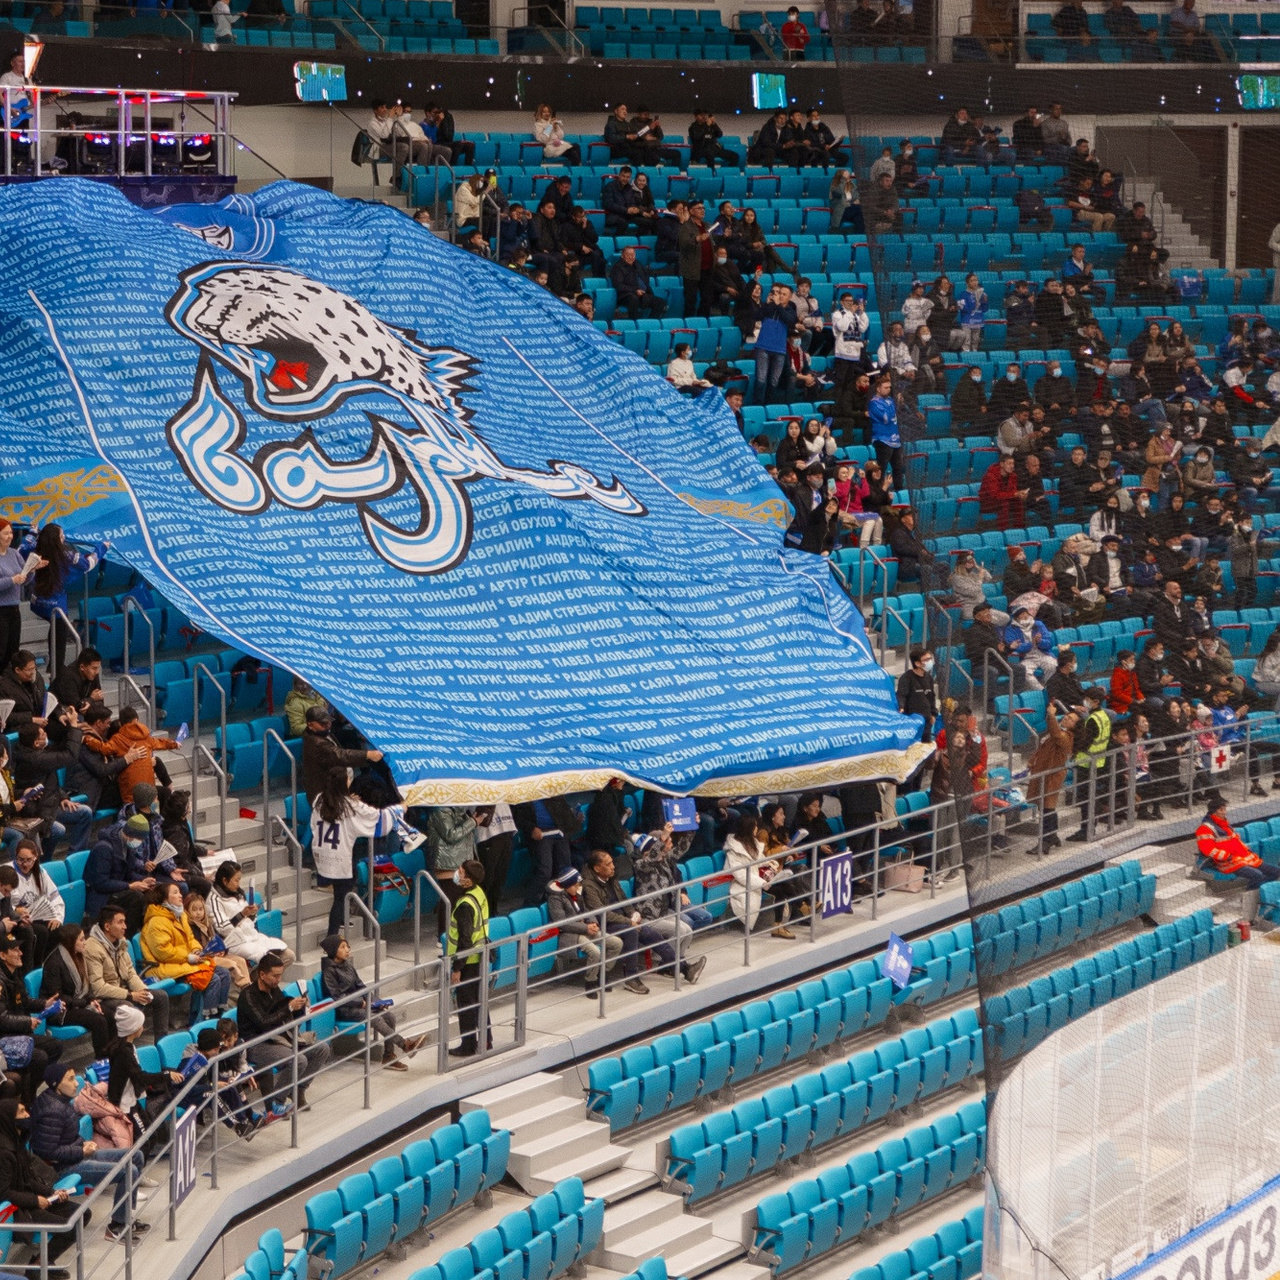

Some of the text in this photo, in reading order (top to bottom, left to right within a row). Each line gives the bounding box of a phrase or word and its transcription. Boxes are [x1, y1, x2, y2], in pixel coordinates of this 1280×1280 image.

[8, 228, 67, 254] ШУМАХЕР
[21, 245, 83, 272] ОРАЗБАЕВ
[92, 260, 144, 272] СЕМЕНОВ
[319, 260, 357, 269] СЕРГЕЙ
[109, 271, 145, 281] УТЕЕВ
[359, 281, 385, 291] ЮРИЙ
[52, 291, 115, 307] ГЛАЗАЧЕВ
[90, 303, 147, 314] РОМАНОВ
[63, 329, 119, 341] МАКСИМ
[109, 340, 142, 351] ВЕЙ
[122, 354, 171, 366] МАРТЕН
[105, 369, 160, 383] МИХАИЛ
[130, 380, 175, 394] МИХАИЛ
[92, 404, 140, 419] НИКИТА
[347, 402, 402, 411] АЛЕКСАНДР
[258, 422, 303, 436] РУСТЕМ
[109, 447, 163, 460] ШПИЛАР
[726, 480, 757, 496] БОРИС
[259, 514, 315, 528] ДМИТРИЙ
[513, 515, 556, 531] ОБУХОВ
[104, 524, 139, 541] РАЙТ
[150, 524, 319, 541] УППЕР ШЕВЧЕНКО
[157, 533, 360, 550] АЛЕКСЕЙ АЛЕКСЕЙ
[166, 546, 373, 564] АЛЕКСЕЙ АЛЕКСЕЙ
[174, 561, 386, 578] ПЕТЕРССОН АНДРЕЙ БОРДЮГ
[185, 552, 570, 592] ПОЛКОВНИКОВ АНДРЕЙ РАЙСКИЙ АНДРЕЙ СПИРИДОНОВ
[198, 569, 591, 605] АРТЁМ ЛИХОТНИКОВ АРТЕМ ТЮТЮНЬКОВ АРТУР ГАТИЯТОВ
[208, 586, 624, 618] БАТЫРЛАН МУРАТОВ БРЭНДЕН БРЭНДОН БОЧЕНСКИ
[220, 589, 766, 632] ВАДИМ КРАСНОСЛОБОДЦЕВ ВАДИМ СОЗИНОВ ВАДИМ СТРЕЛЬЧУК ВИКТОР
[233, 626, 287, 636] ВИКТОР
[288, 629, 340, 644] ТЕРЕХОВ
[350, 631, 408, 645] ВИТАЛИЙ
[505, 624, 560, 641] ВИТАЛИЙ
[562, 617, 624, 636] ШУМИЛОВ
[740, 597, 800, 619] ВЛАДИМИР
[322, 645, 386, 658] МАРКЕЛОВ
[394, 645, 460, 656] ВЛАДИМИР
[525, 639, 589, 655] ВЛАДИМИР
[591, 632, 655, 648] СТРЕЛЬЧУК
[719, 622, 768, 640] НИКУЛИН
[386, 658, 454, 673] ВЯЧЕСЛАВ
[454, 658, 544, 671] ФАЛЬФУДИНОВ
[551, 654, 593, 669] ПАВЕЛ
[594, 647, 654, 662] АКОЛЬЗИН
[741, 635, 780, 652] ПАВЕЛ
[383, 646, 813, 688] ЦУКАНОВ ПАТРИС РАДИК ШАНГАРЕЕВ РИНАТ
[479, 691, 521, 702] АНТОН
[528, 688, 573, 700] САЛИМ
[573, 682, 632, 698] ПРМАНОВ
[641, 676, 675, 691] САЯН
[675, 672, 719, 686] ДАНИЯР
[450, 704, 498, 716] СЕРГЕЙ
[500, 702, 587, 717] ЛАВРЕНТЬЕВ
[597, 696, 646, 708] СЕРГЕЙ
[648, 686, 725, 704] МЕЛЬНИКОВ
[733, 679, 777, 691] СЕРГЕЙ
[467, 721, 531, 733] ТРИФОНОВ
[538, 714, 585, 728] СЕРГЕЙ
[608, 720, 658, 734] ТРЕВОР
[622, 734, 680, 753] ПОПОВИЧ
[689, 724, 726, 739] ЮРИЙ
[396, 757, 445, 774] ГЕОРГИЙ
[445, 759, 508, 772] МУСАТАЕВ
[641, 742, 723, 770] КОЛЕСНИКОВ
[728, 728, 800, 747] ВЛАДИСЛАВ
[685, 731, 893, 778] ТРОЩИНСКИЙ АРКАДИЙ ШЕСТАКОВ
[316, 820, 340, 850] 14
[823, 860, 852, 913] A13
[176, 1119, 196, 1201] A12
